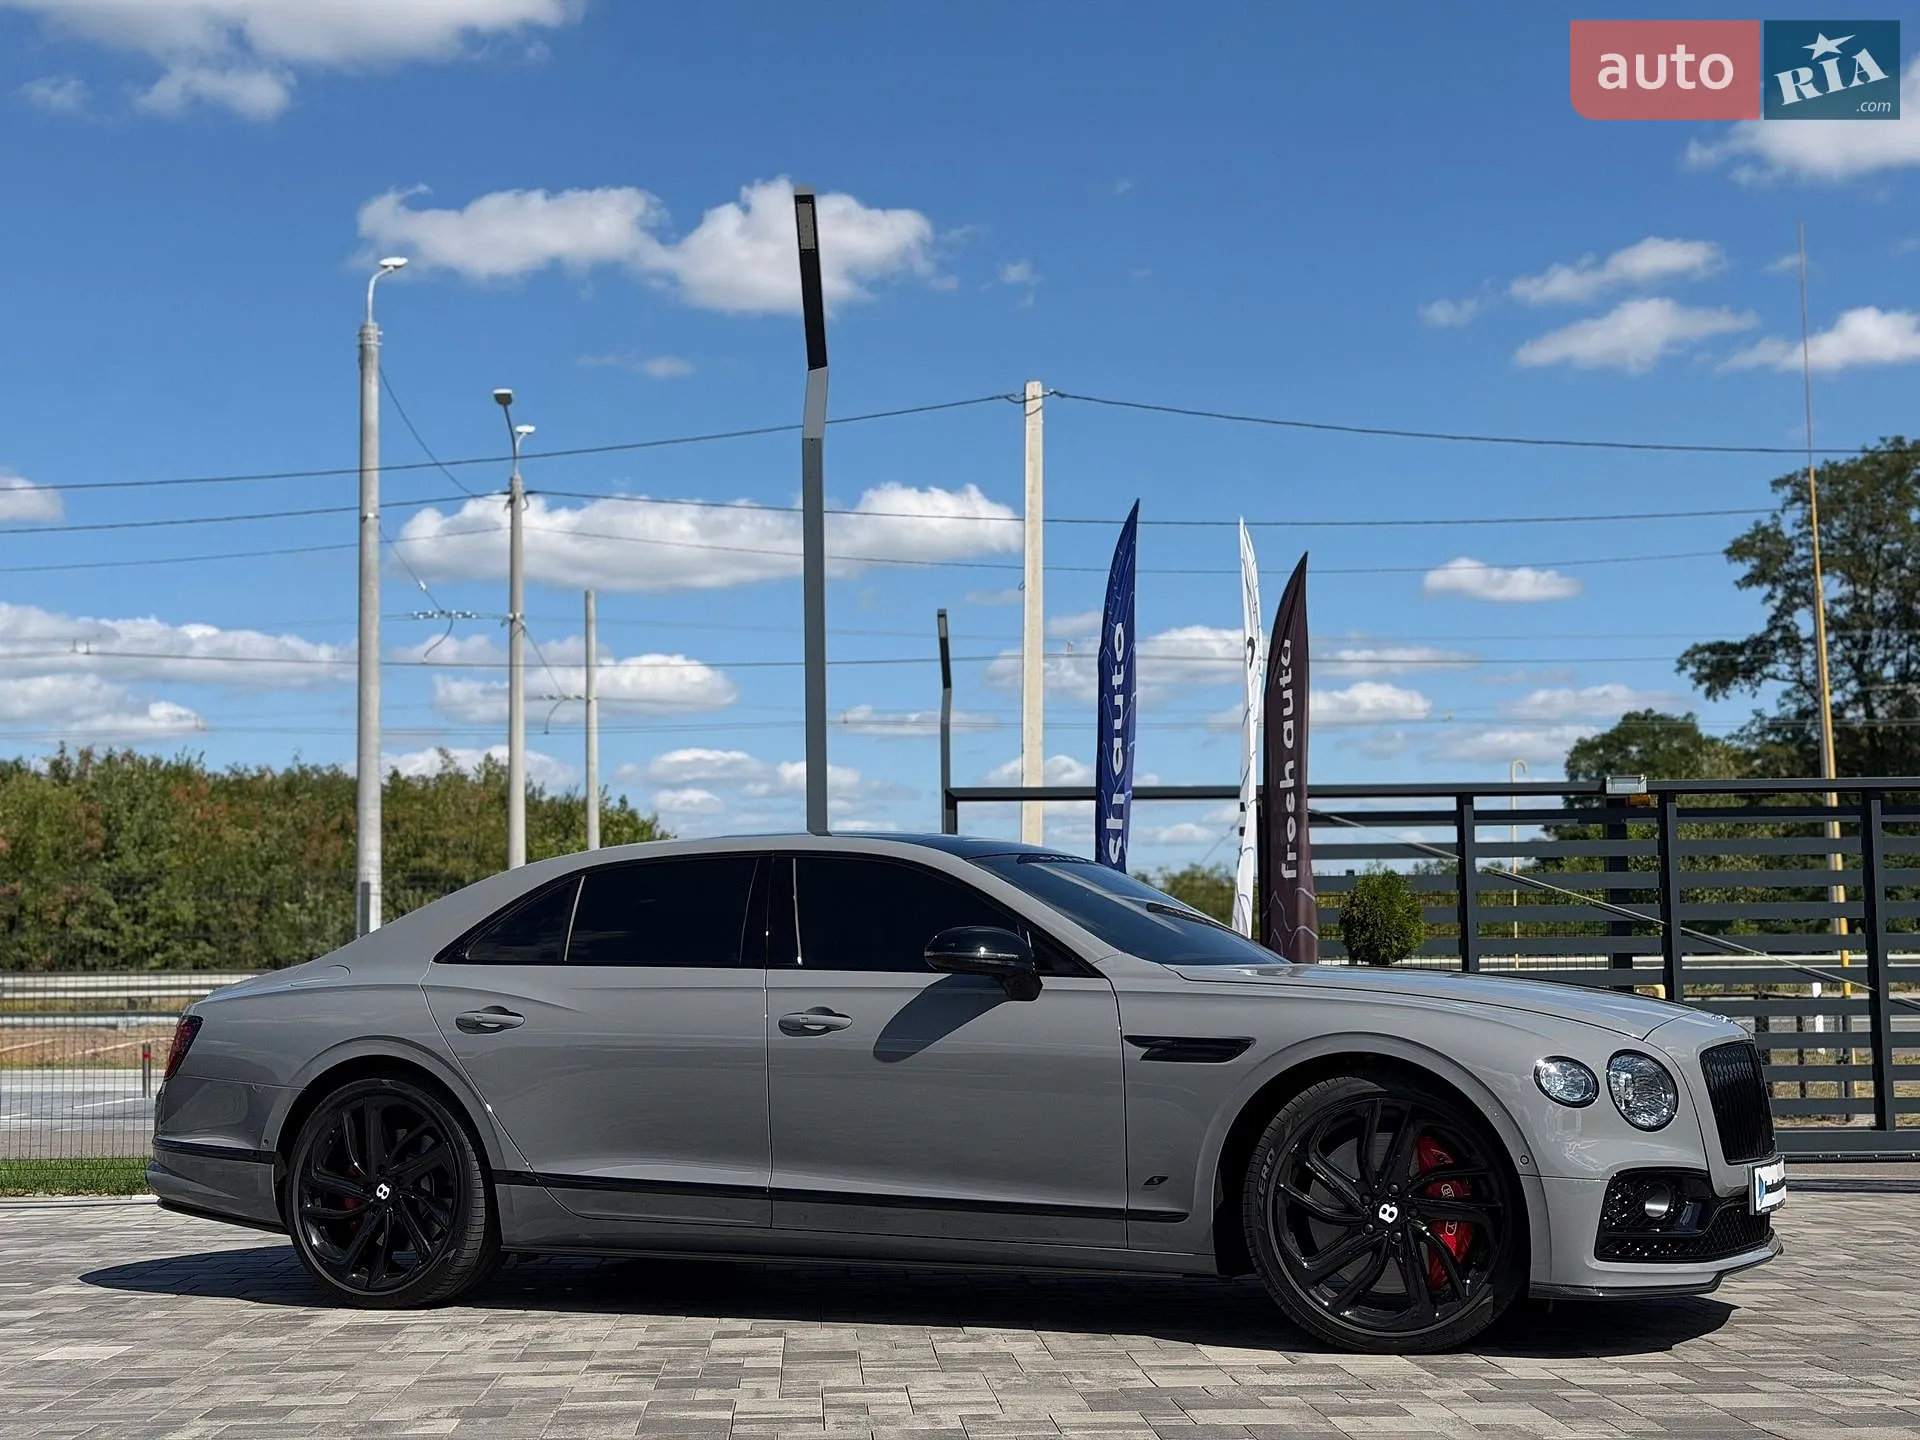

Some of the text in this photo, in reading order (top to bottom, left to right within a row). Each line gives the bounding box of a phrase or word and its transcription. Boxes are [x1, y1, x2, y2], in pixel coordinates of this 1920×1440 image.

[1111, 622, 1124, 776] auto
[1279, 639, 1294, 749] auto
[1378, 1203, 1399, 1224] B
